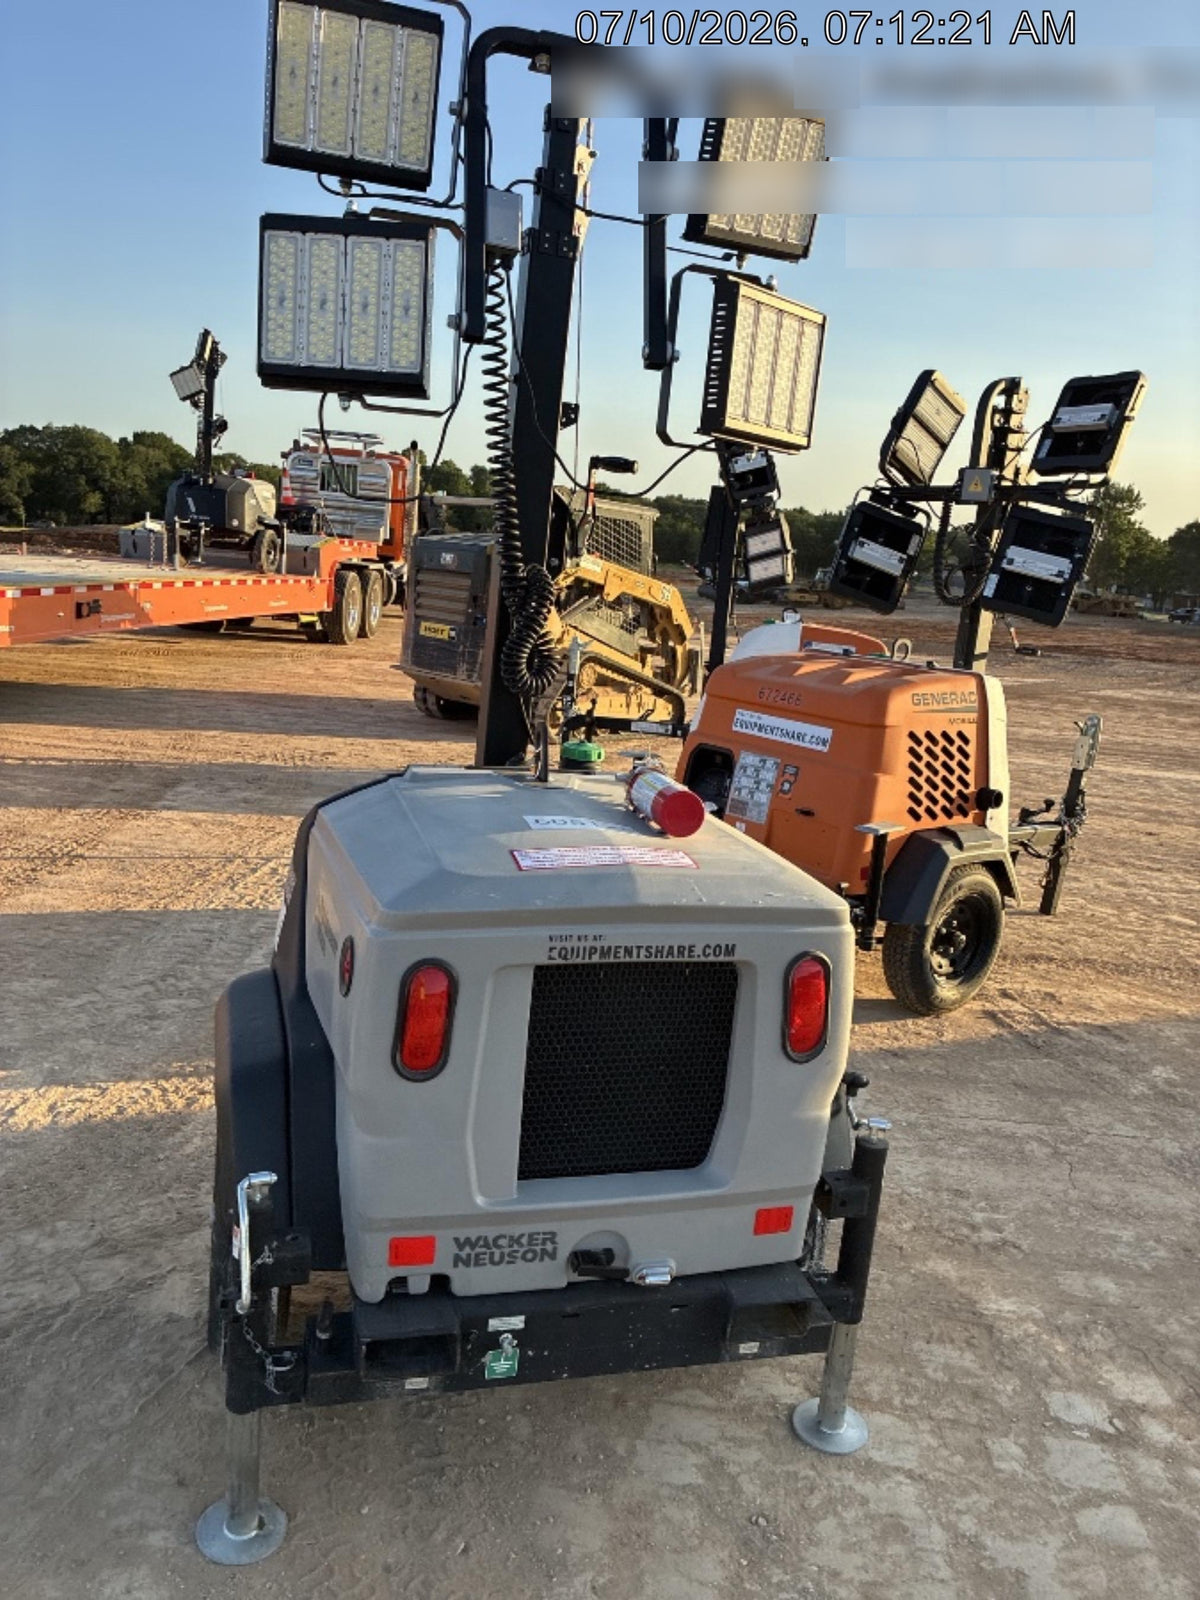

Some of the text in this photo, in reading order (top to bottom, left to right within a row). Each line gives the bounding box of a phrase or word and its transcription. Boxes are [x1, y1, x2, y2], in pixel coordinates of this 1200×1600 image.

[911, 691, 978, 707] GENERAC
[734, 718, 829, 748] EQUIPMENTSHARE.COM
[549, 934, 574, 943] VISIT
[577, 934, 588, 943] US
[547, 943, 737, 961] EQUIPMENTSHARE.COM
[452, 1231, 559, 1252] WACKER
[452, 1246, 558, 1269] NEUSON
